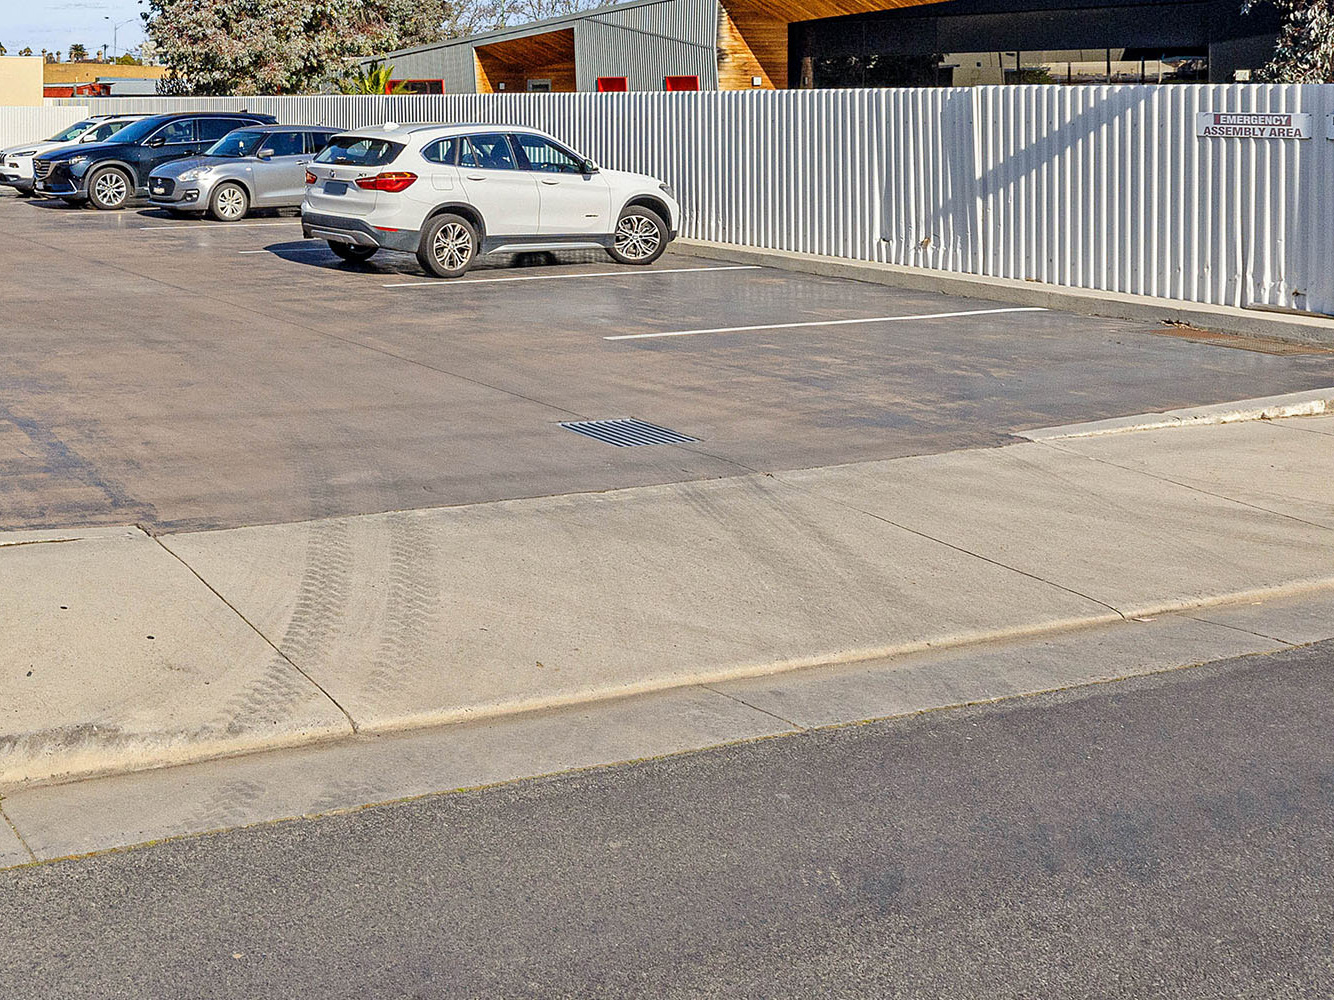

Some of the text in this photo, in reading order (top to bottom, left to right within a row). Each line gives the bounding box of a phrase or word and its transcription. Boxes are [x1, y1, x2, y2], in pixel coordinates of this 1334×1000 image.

[1219, 115, 1288, 125] EMERGENCY
[1203, 126, 1302, 138] ASSEMBLY AREA
